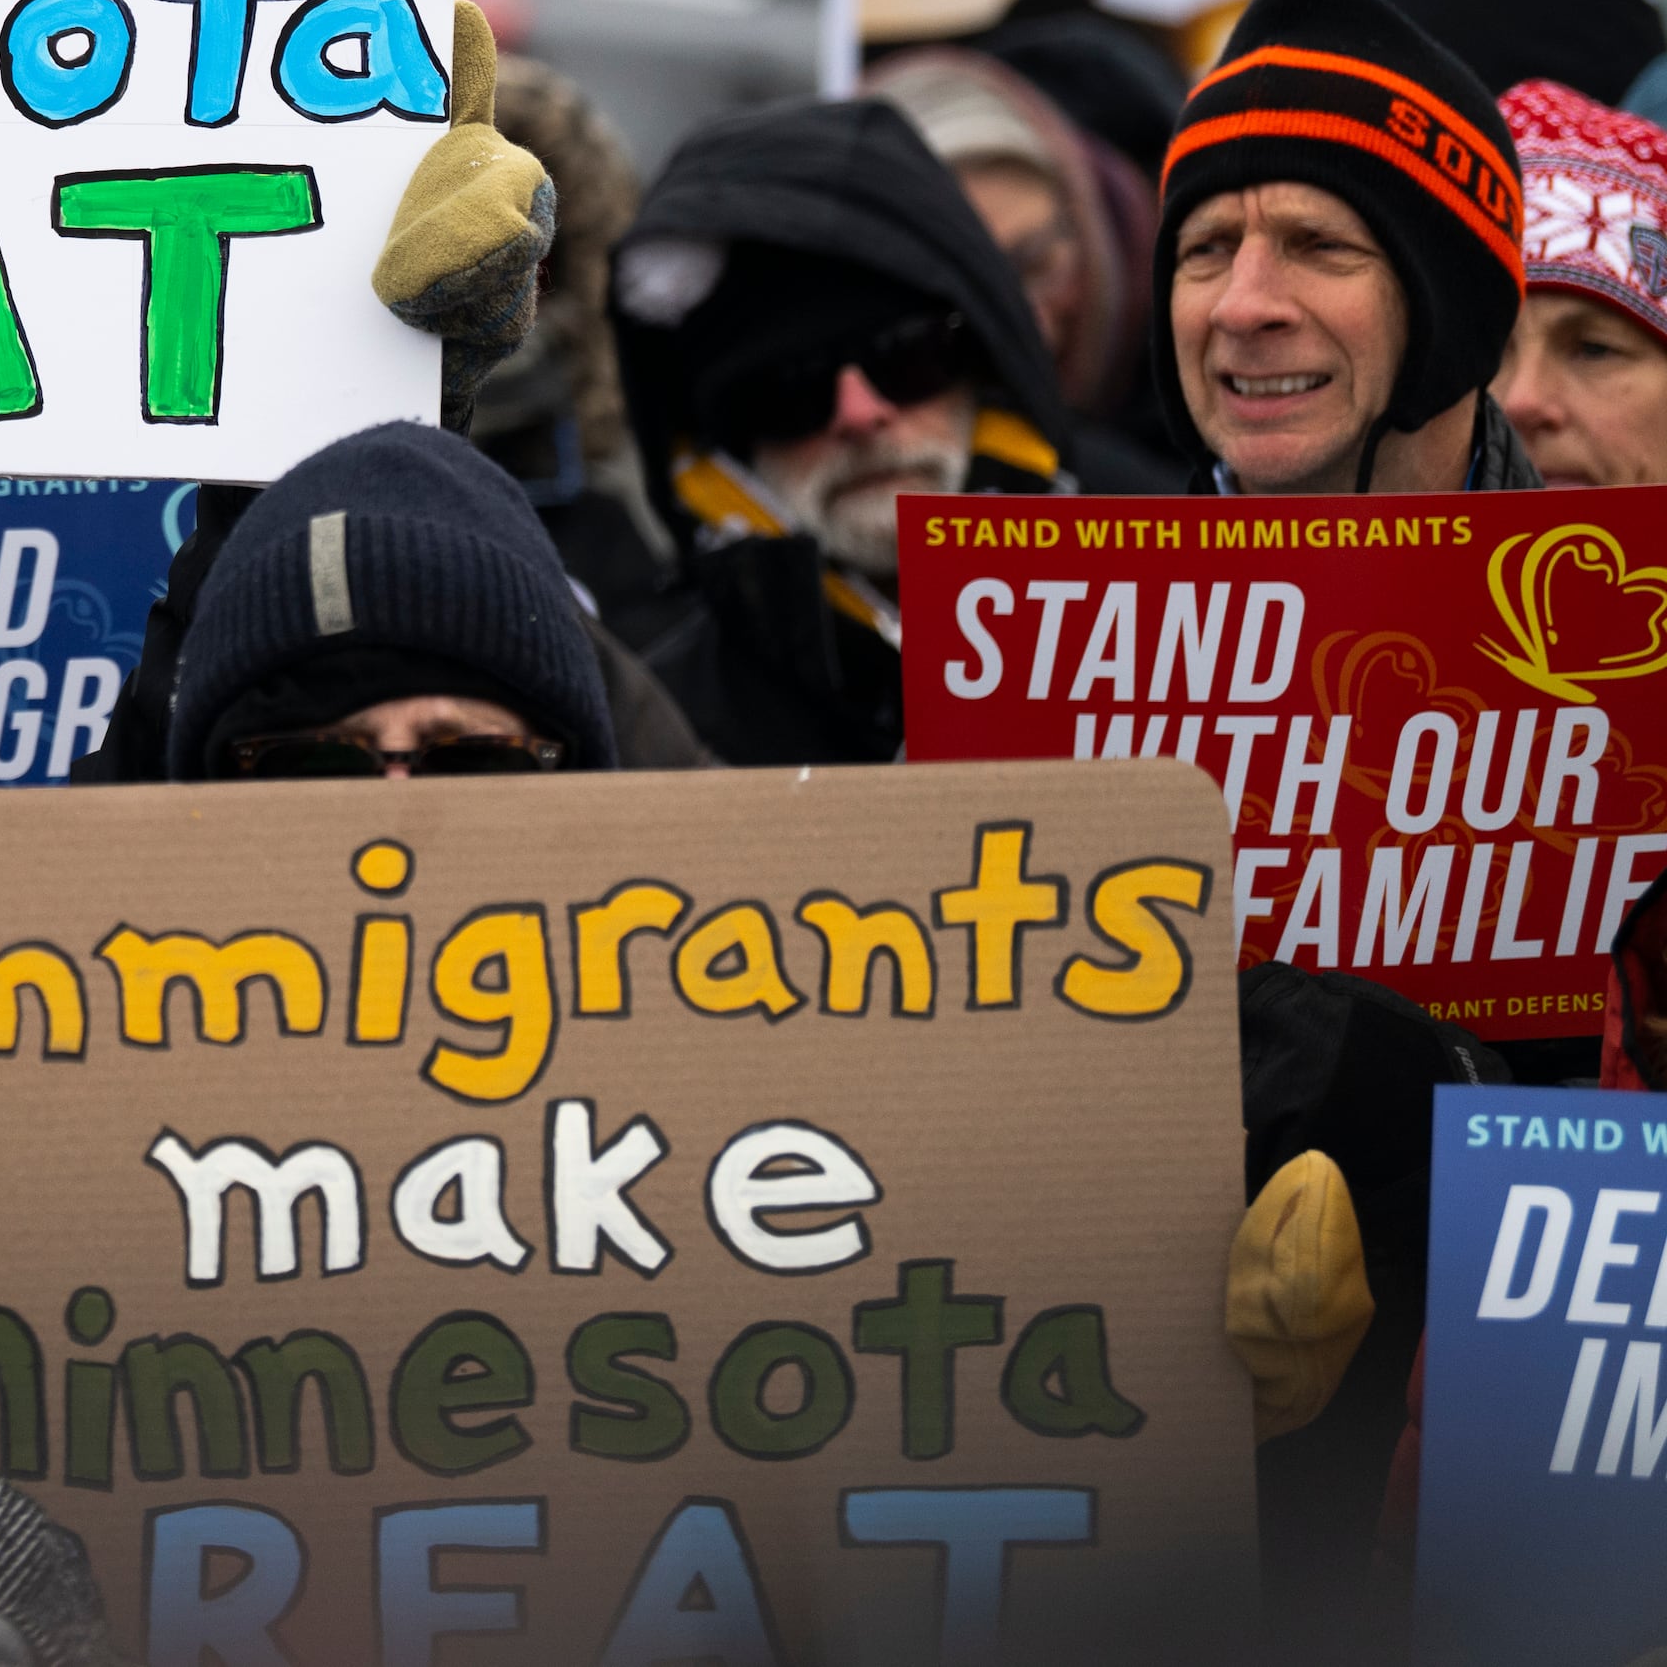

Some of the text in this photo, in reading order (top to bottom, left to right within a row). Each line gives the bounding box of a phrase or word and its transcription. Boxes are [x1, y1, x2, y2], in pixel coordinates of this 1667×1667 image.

[1386, 99, 1519, 239] SOU
[925, 516, 1473, 549] STAND WITH IMMIGRANTS
[943, 577, 1306, 703] STAND
[1385, 706, 1610, 834] OUR
[1234, 833, 1667, 968] FAMILIE
[1507, 992, 1605, 1016] DEFENS
[146, 1098, 883, 1288] make
[1467, 1114, 1624, 1152] STAND
[145, 1485, 1099, 1667] REAT
